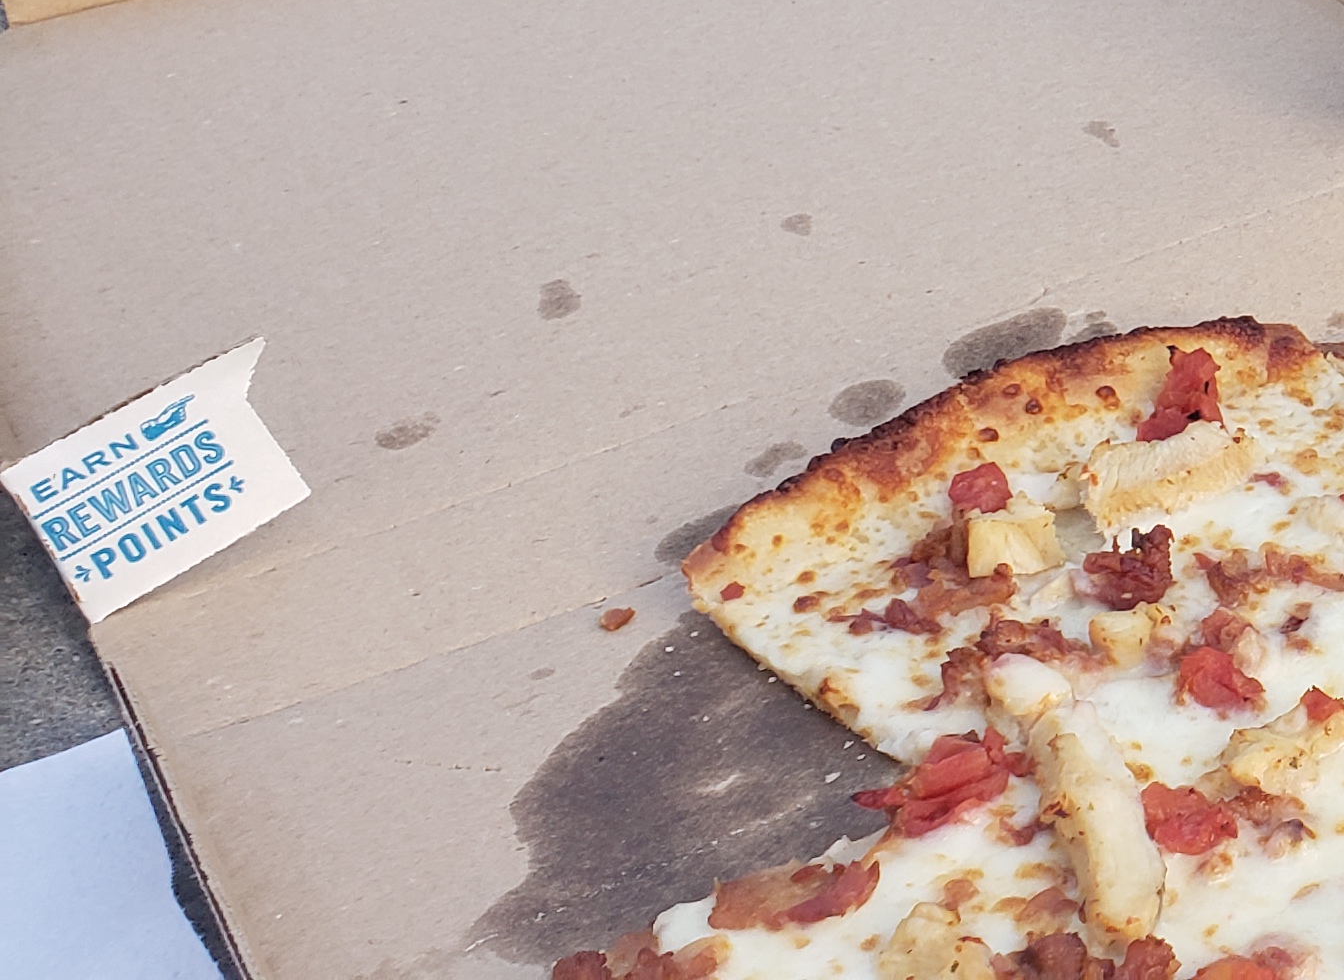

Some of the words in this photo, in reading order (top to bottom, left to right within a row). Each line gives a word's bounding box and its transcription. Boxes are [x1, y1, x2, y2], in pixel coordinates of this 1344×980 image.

[29, 433, 140, 504] EARN
[41, 431, 226, 552] REWARDS
[90, 482, 232, 580] POINTS
